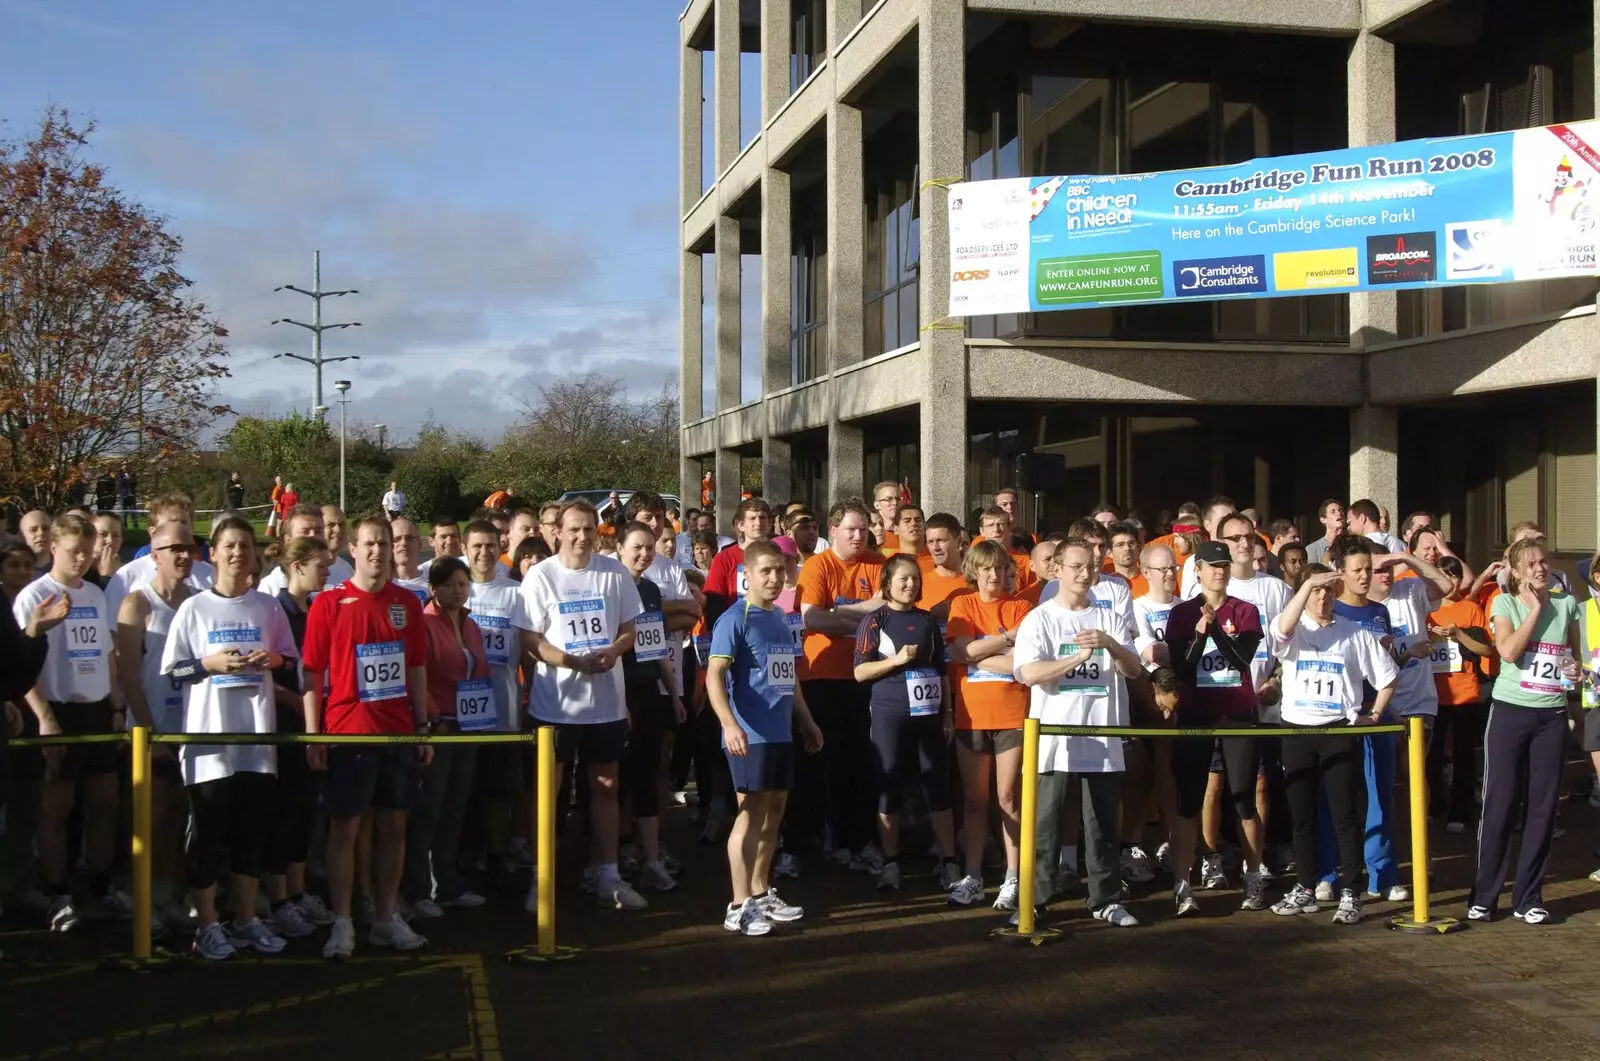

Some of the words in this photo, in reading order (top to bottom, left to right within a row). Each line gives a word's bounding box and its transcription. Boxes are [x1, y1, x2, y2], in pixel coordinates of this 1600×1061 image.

[1562, 131, 1580, 148] 20th
[1176, 170, 1305, 196] Cambridge
[1311, 165, 1361, 183] Fun
[1368, 159, 1422, 177] Run
[1430, 150, 1494, 175] 2008
[1067, 185, 1091, 196] BBC
[1066, 193, 1137, 214] Children
[1174, 201, 1239, 217] 11:55am
[1253, 195, 1302, 212] Friday
[1309, 190, 1344, 205] 14th
[1349, 183, 1435, 203] November
[1067, 214, 1081, 231] in
[1172, 227, 1201, 240] Here
[1205, 228, 1221, 238] on
[1224, 222, 1244, 236] the
[1247, 216, 1321, 234] Cambridge
[1325, 214, 1376, 229] Science
[1381, 207, 1415, 223] Park!
[1569, 254, 1596, 263] RUN
[1047, 270, 1075, 279] ENTER
[1077, 266, 1111, 276] ONLINE
[1113, 265, 1137, 274] NOW
[1139, 264, 1150, 273] AT
[1199, 264, 1254, 277] Cambridge
[1305, 268, 1347, 277] revolution
[1040, 276, 1158, 292] WWW.CAMFUNRUN.ORG
[1200, 275, 1259, 288] Consultants
[71, 626, 97, 643] 102
[567, 617, 602, 636] 118
[637, 629, 661, 647] 098
[364, 662, 401, 683] 052
[772, 661, 794, 679] 093
[914, 684, 940, 701] 022
[1303, 678, 1335, 697] 111
[460, 697, 489, 715] 097
